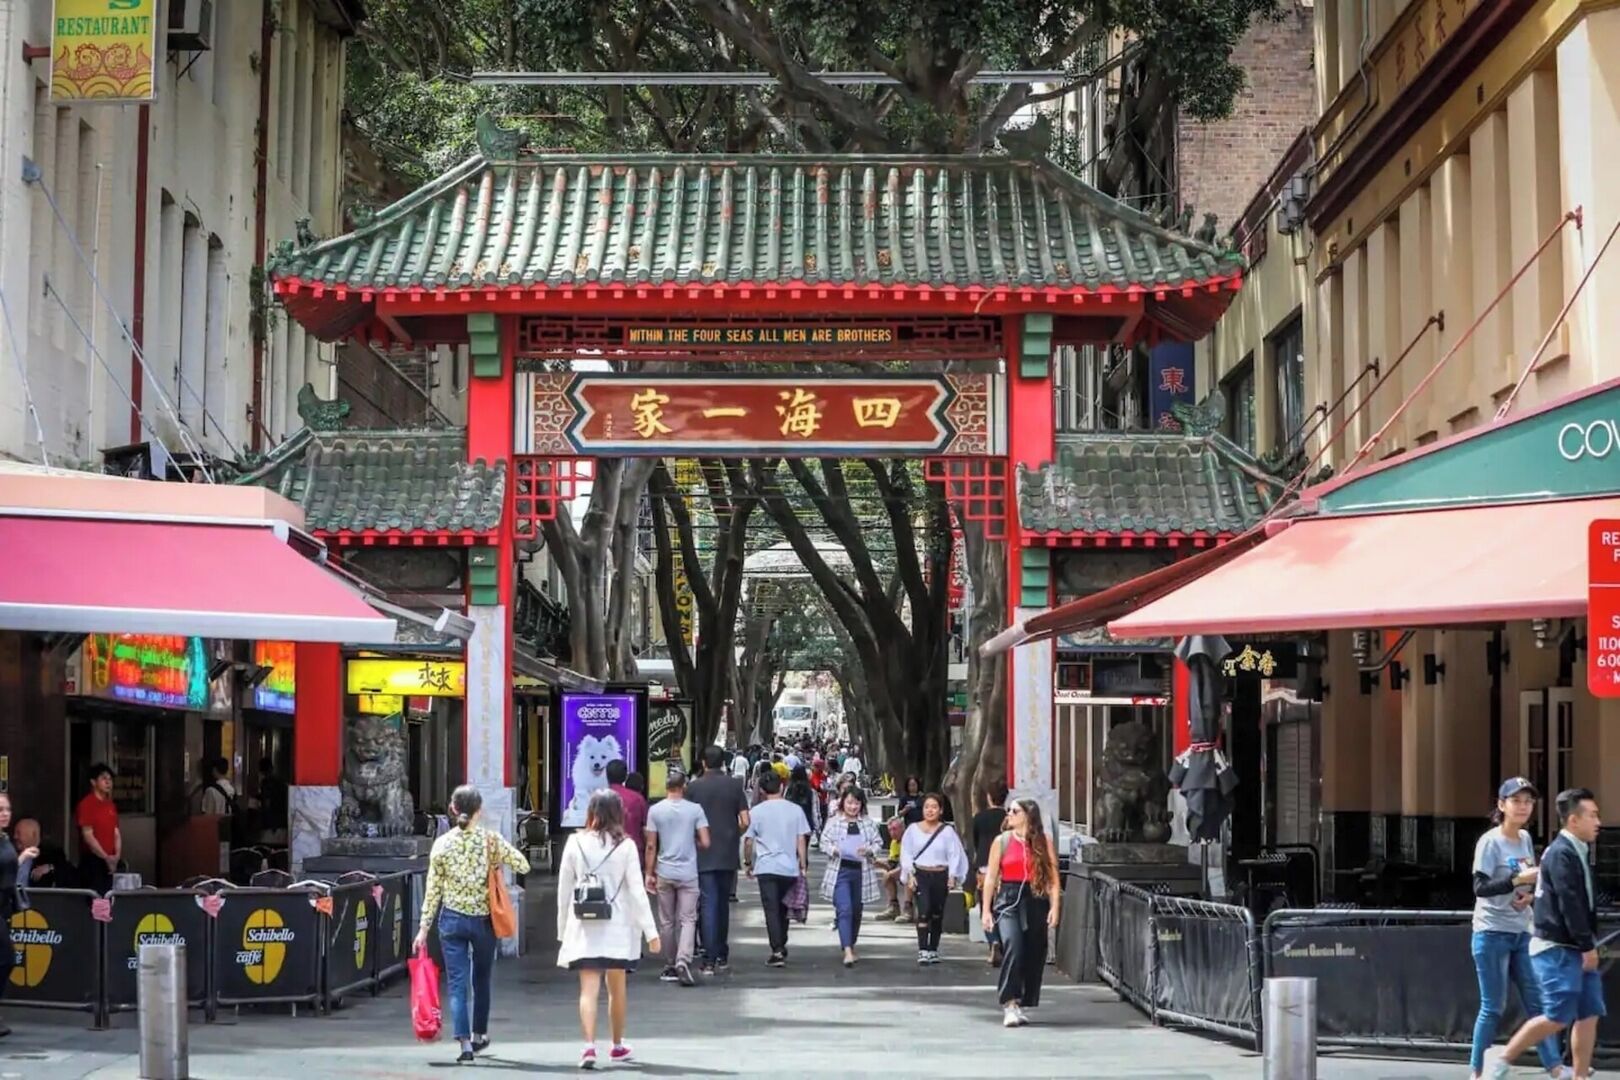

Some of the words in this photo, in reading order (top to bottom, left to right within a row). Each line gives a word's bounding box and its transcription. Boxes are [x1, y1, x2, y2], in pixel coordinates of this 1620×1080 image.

[57, 16, 149, 36] RESTAURANT
[630, 328, 663, 342] WITHIN
[668, 329, 689, 341] THE
[693, 329, 721, 342] FOUR
[727, 329, 754, 342] SEAS
[759, 329, 780, 342] ALL
[784, 329, 806, 342] MEN
[812, 329, 833, 342] ARE
[837, 329, 892, 342] BROTHERS
[648, 707, 681, 734] medy
[247, 927, 296, 942] Schibello
